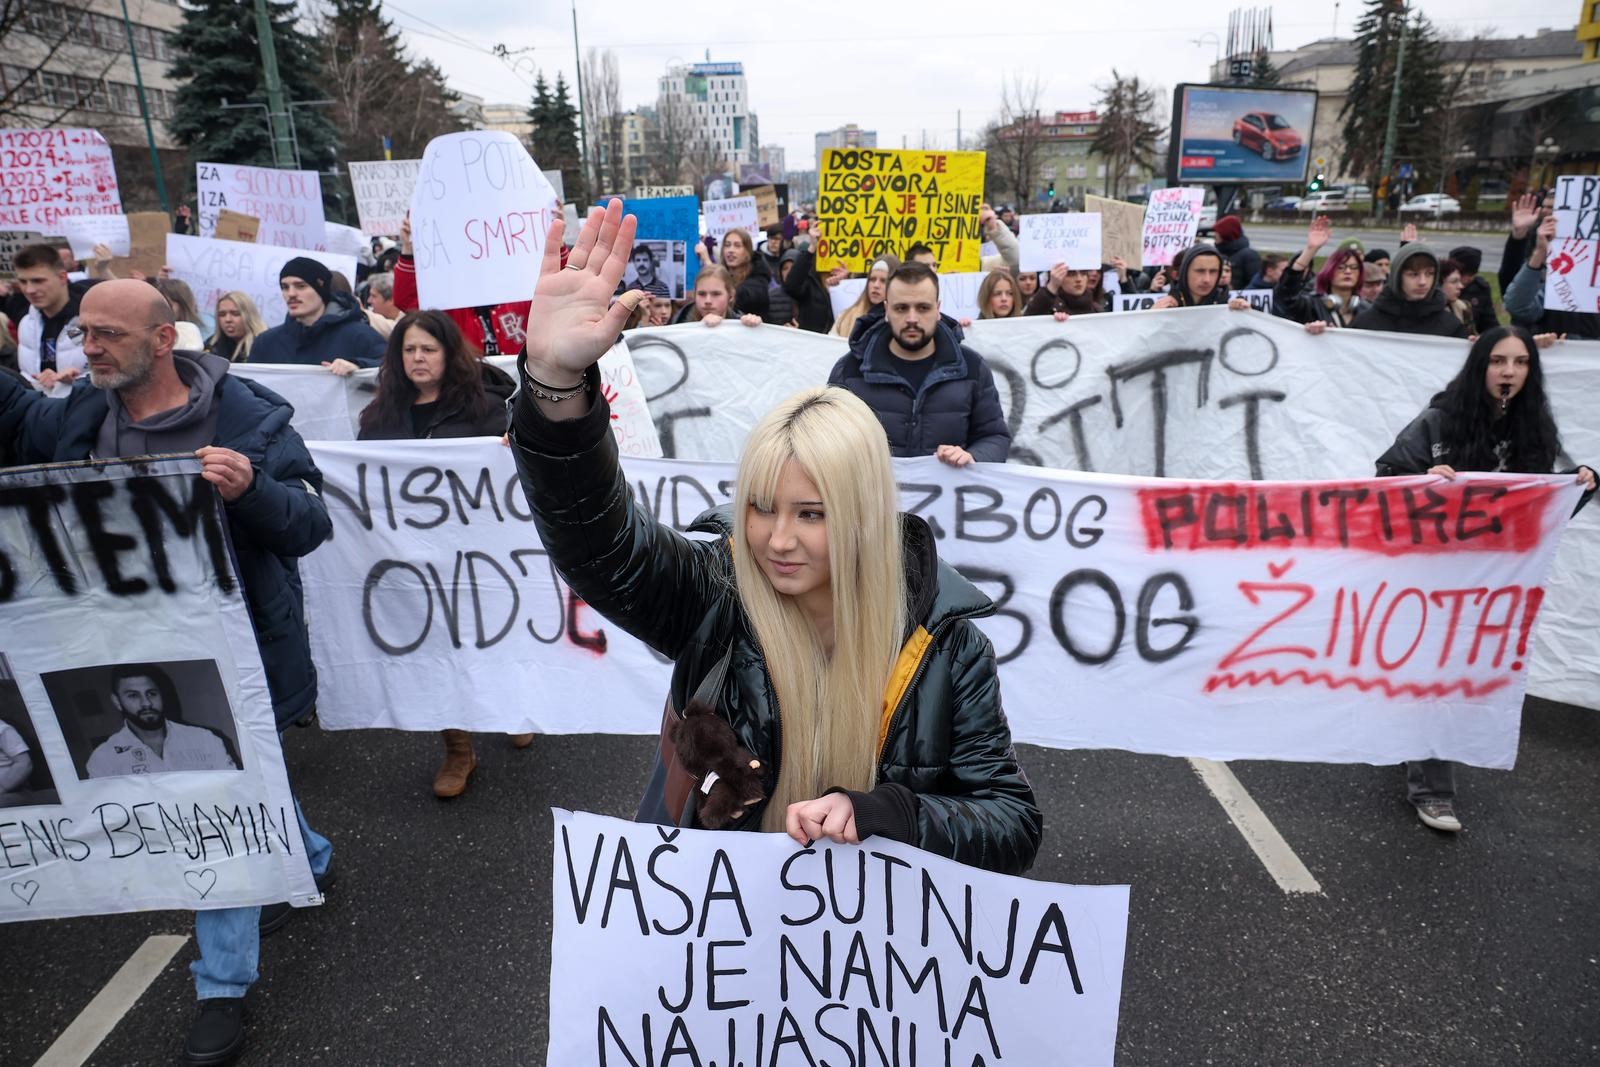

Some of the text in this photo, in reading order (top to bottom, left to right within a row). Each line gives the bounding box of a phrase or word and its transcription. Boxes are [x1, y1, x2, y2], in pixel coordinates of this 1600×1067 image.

[200, 165, 220, 181] ZA
[418, 150, 447, 206] AŠ
[823, 173, 939, 193] IZGOVORA
[829, 150, 947, 173] DOSTA JE
[820, 193, 889, 215] DOSTA
[895, 194, 917, 214] JE
[927, 216, 980, 240] ISTINU
[322, 463, 534, 538] NISMO
[1154, 485, 1507, 550] POLITIKE
[0, 474, 235, 600] TEM
[1216, 558, 1546, 671] ŽIVOTA!
[0, 818, 91, 869] ENIS
[561, 824, 753, 938] VAŠA
[657, 929, 1002, 1060] JE NAMA
